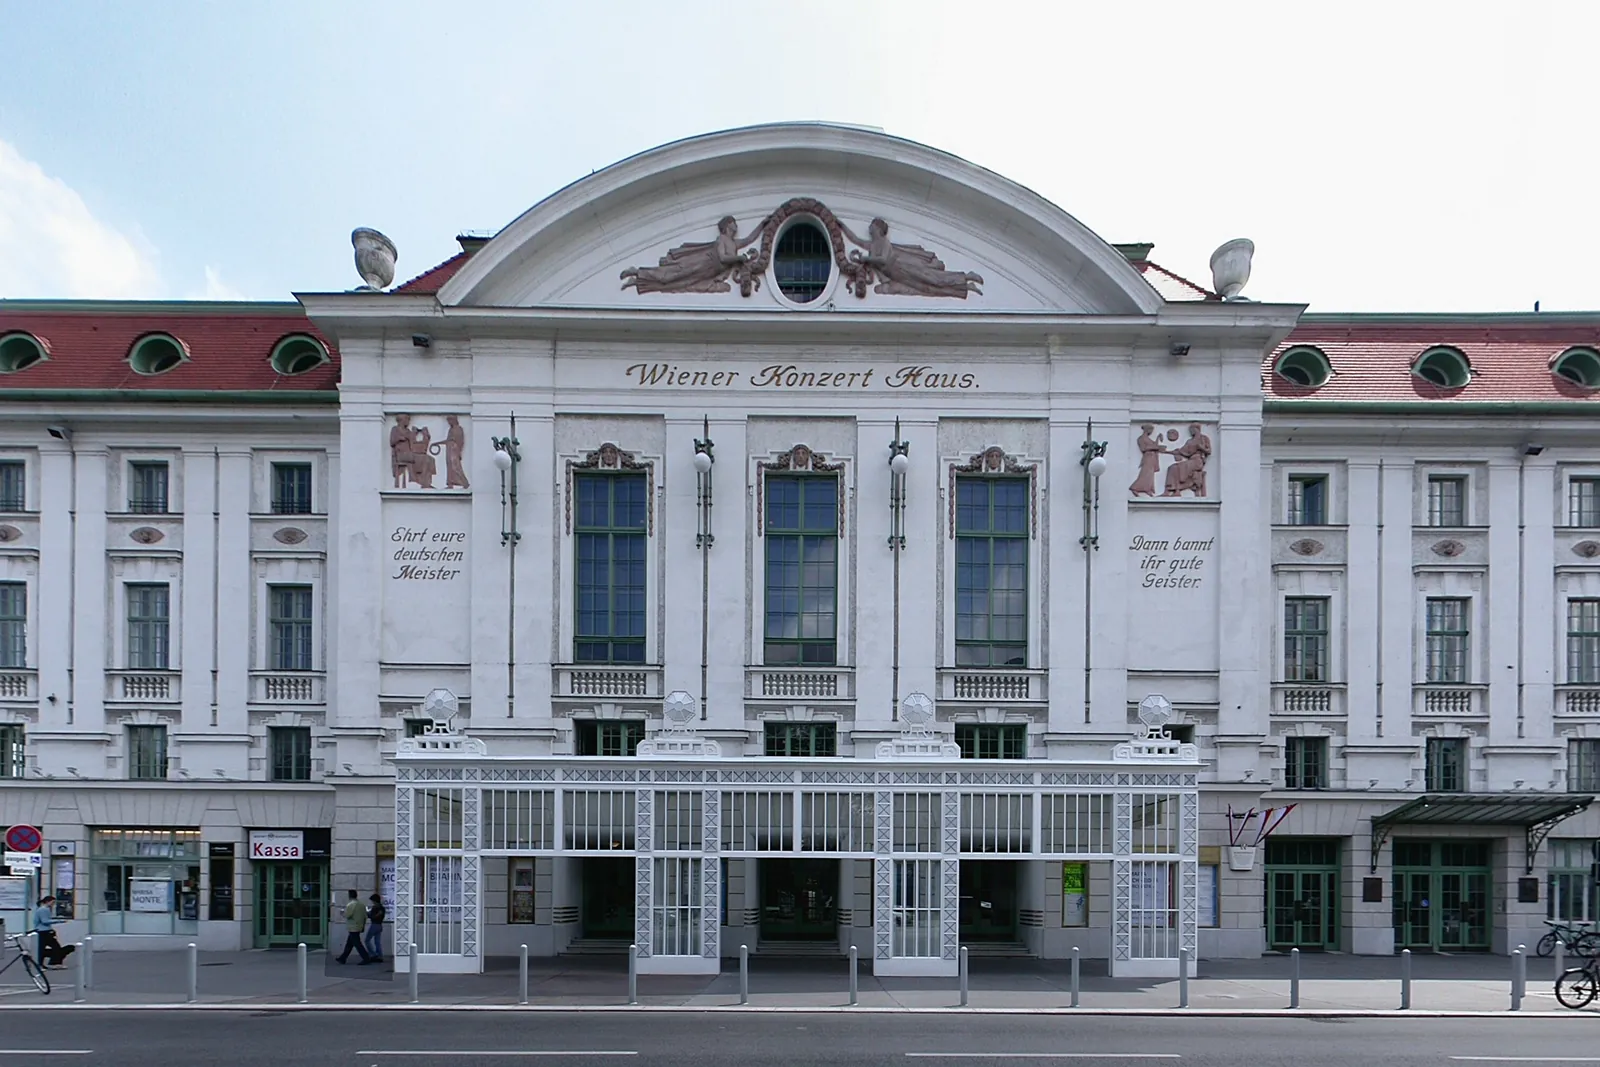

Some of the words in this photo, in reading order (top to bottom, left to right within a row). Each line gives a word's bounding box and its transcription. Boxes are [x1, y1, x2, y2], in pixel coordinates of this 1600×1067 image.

[625, 363, 739, 386] Wiener
[750, 365, 873, 388] Konzert
[885, 366, 980, 389] Haus.
[391, 526, 428, 542] Ehrt
[432, 532, 466, 542] eure
[1129, 534, 1169, 551] Dann
[1173, 536, 1215, 551] bannt
[393, 546, 464, 562] deutschen
[392, 564, 461, 580] Meister
[1140, 554, 1166, 570] ihr
[1169, 555, 1204, 575] gute
[1142, 572, 1202, 589] Geister.
[253, 842, 299, 857] Kassa
